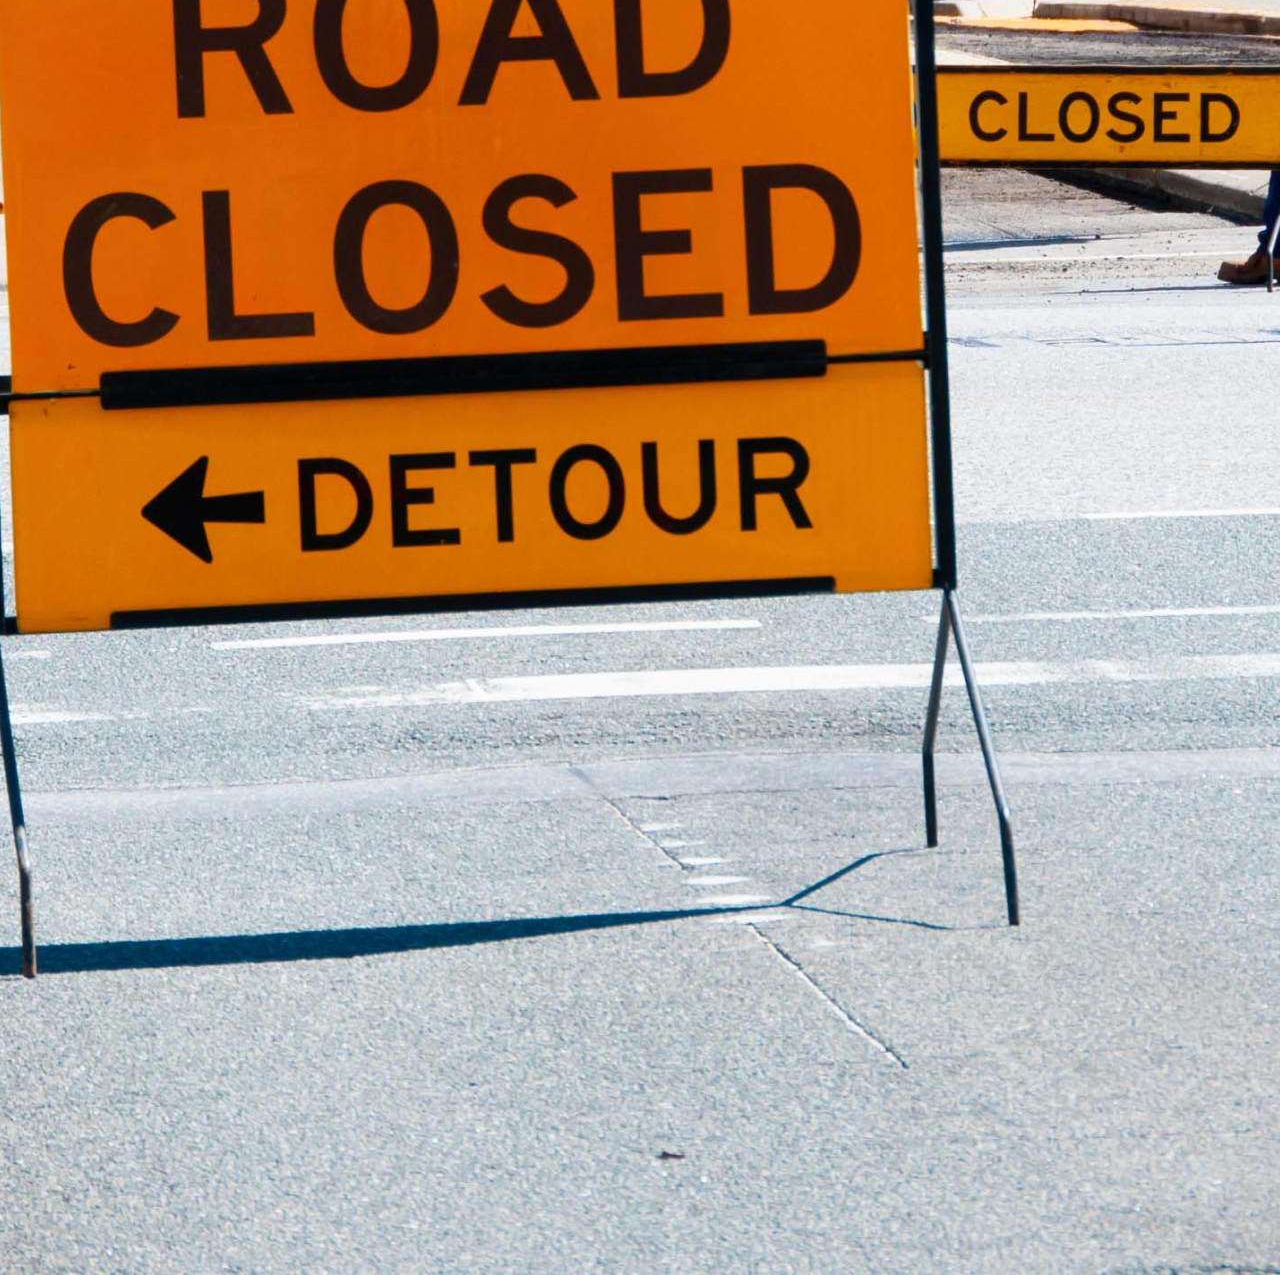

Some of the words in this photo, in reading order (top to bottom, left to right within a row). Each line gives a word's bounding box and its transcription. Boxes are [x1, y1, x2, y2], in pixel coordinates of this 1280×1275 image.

[969, 90, 1240, 143] CLOSED
[62, 163, 862, 349] CLOSED
[297, 437, 813, 553] DETOUR
